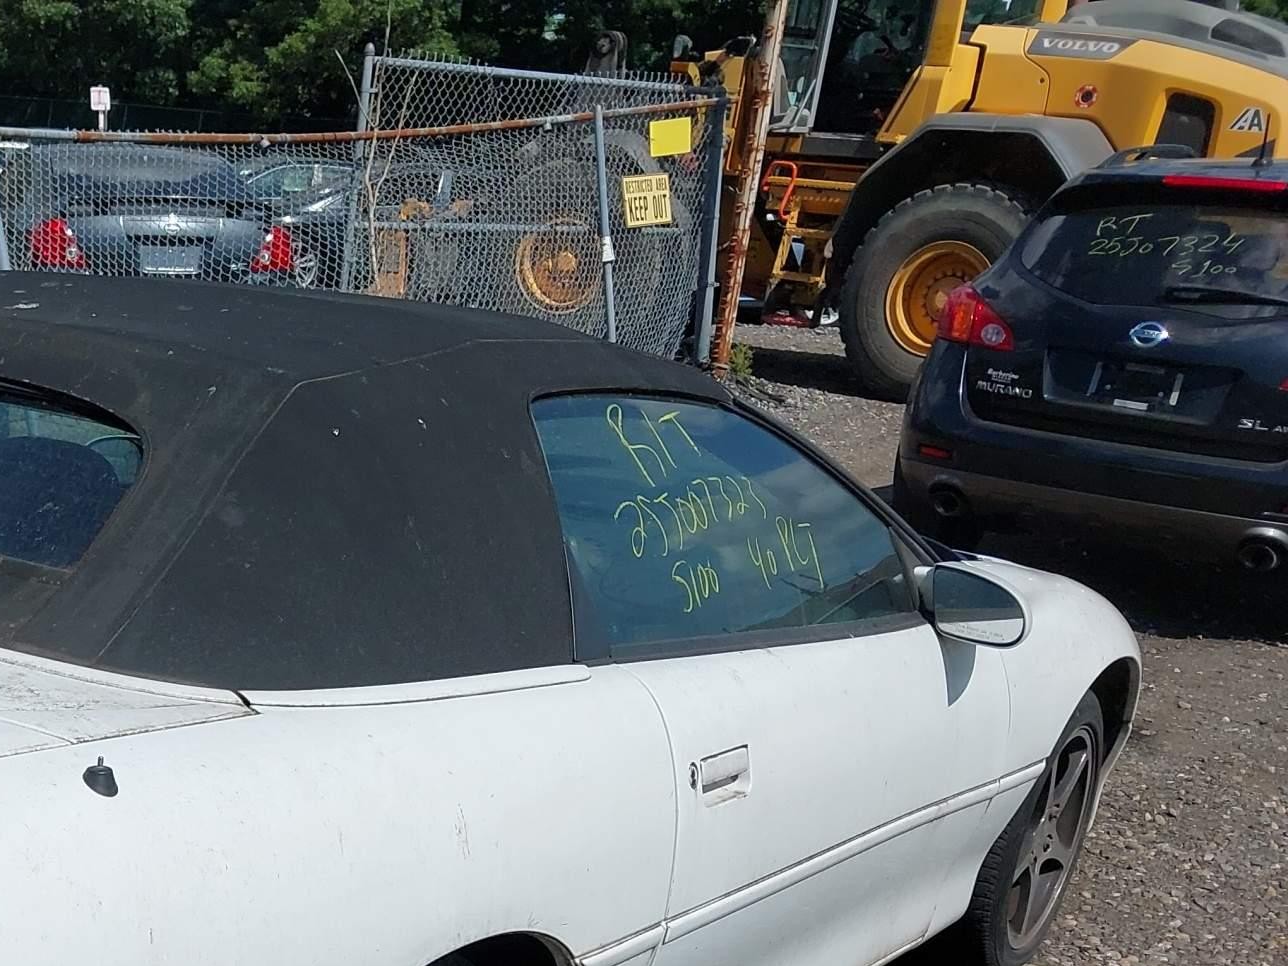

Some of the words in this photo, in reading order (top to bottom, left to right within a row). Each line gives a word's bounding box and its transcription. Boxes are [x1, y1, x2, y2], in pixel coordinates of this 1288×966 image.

[1041, 37, 1120, 54] VOLVO
[624, 179, 653, 194] RESTRICTED
[655, 177, 668, 191] AREA
[627, 195, 649, 222] KEEP
[652, 194, 669, 219] OUT
[976, 380, 1033, 399] MURANO
[1237, 418, 1270, 431] SL
